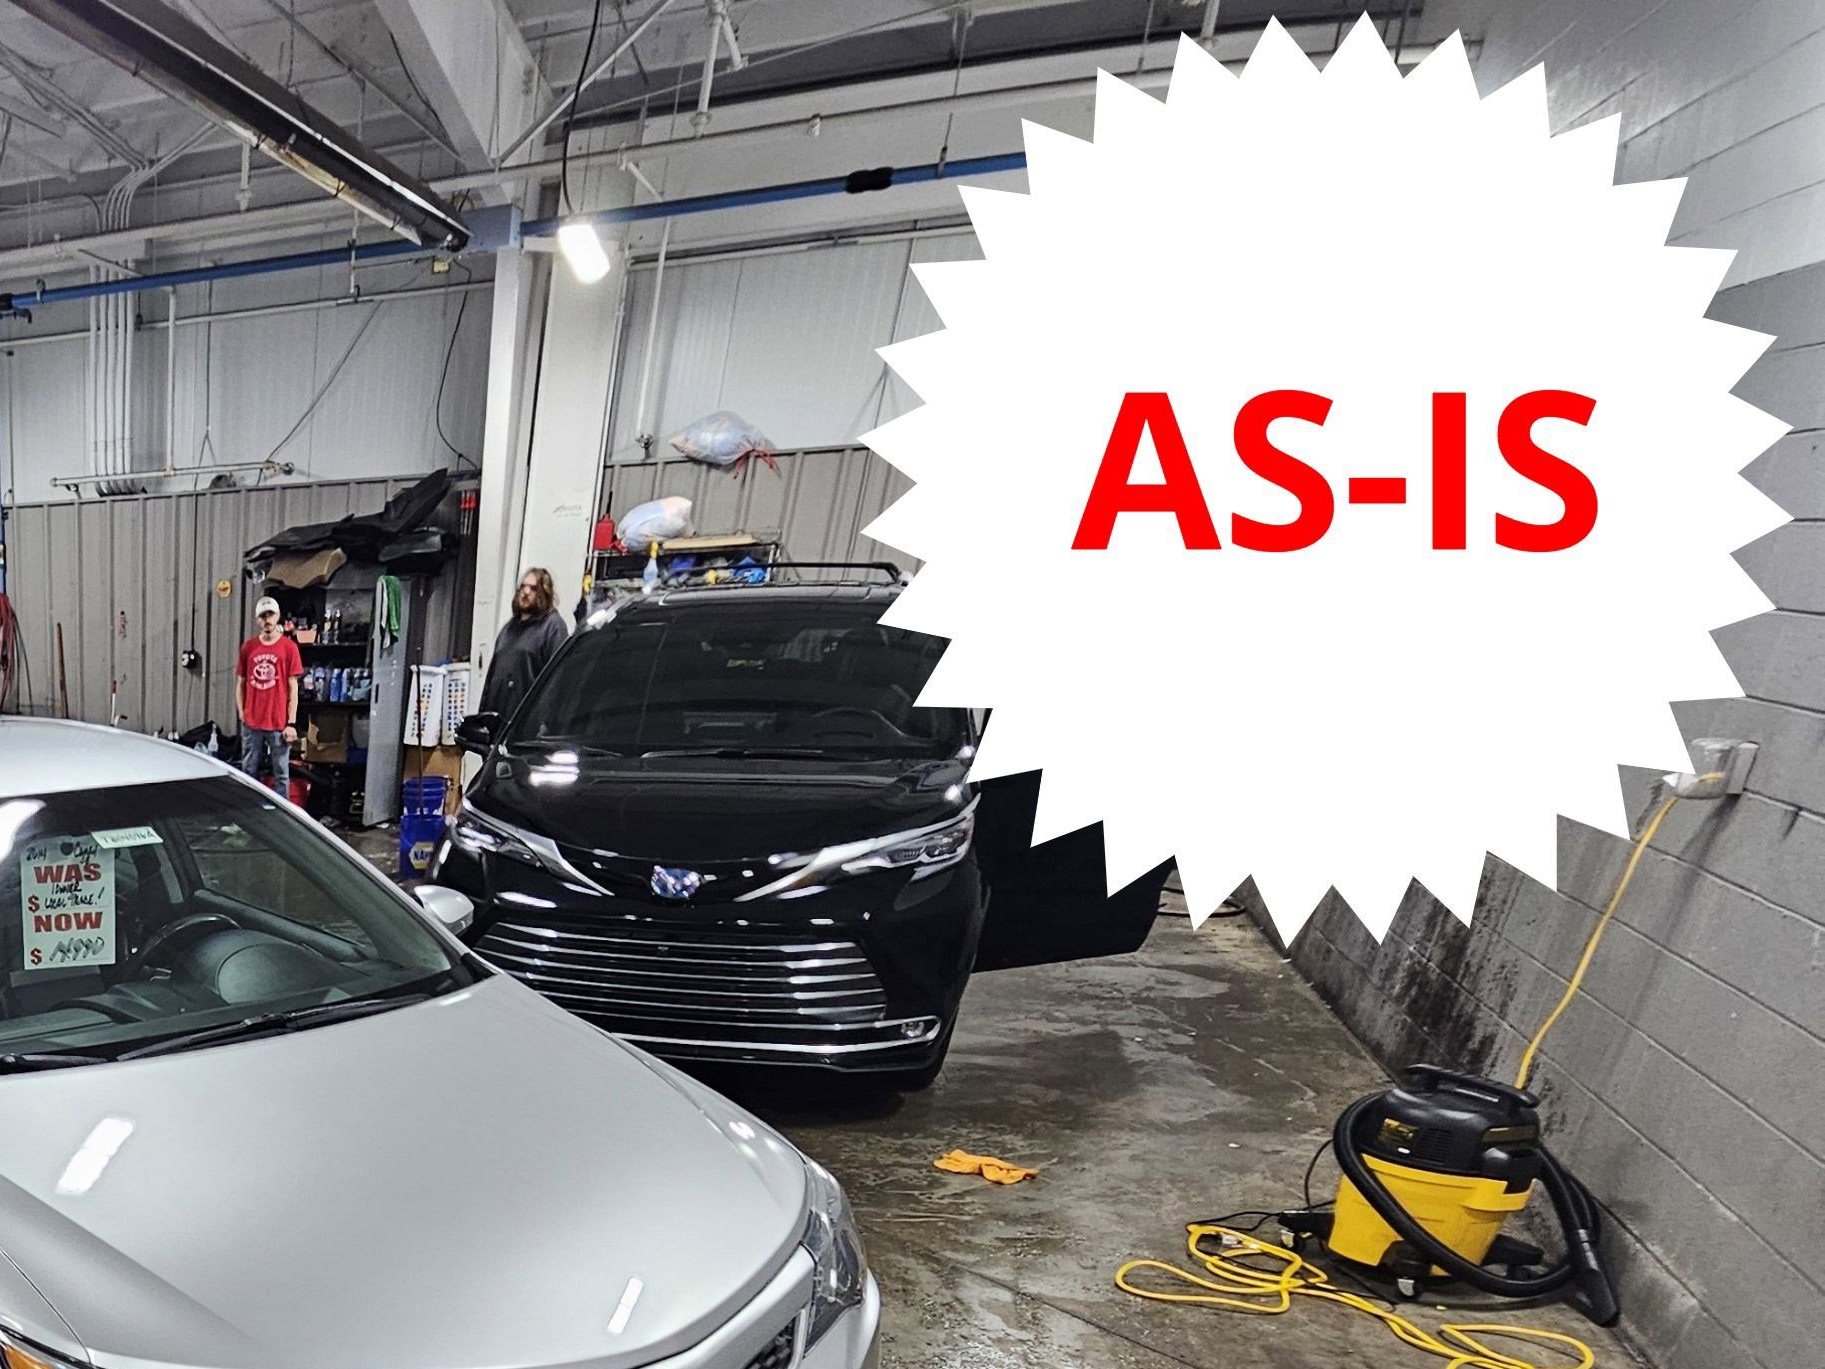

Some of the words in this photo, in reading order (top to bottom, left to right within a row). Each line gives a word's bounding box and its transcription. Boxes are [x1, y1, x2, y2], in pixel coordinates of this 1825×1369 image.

[34, 863, 102, 884] WAS
[27, 894, 41, 914] $
[34, 912, 103, 933] NOW
[30, 947, 43, 966] $
